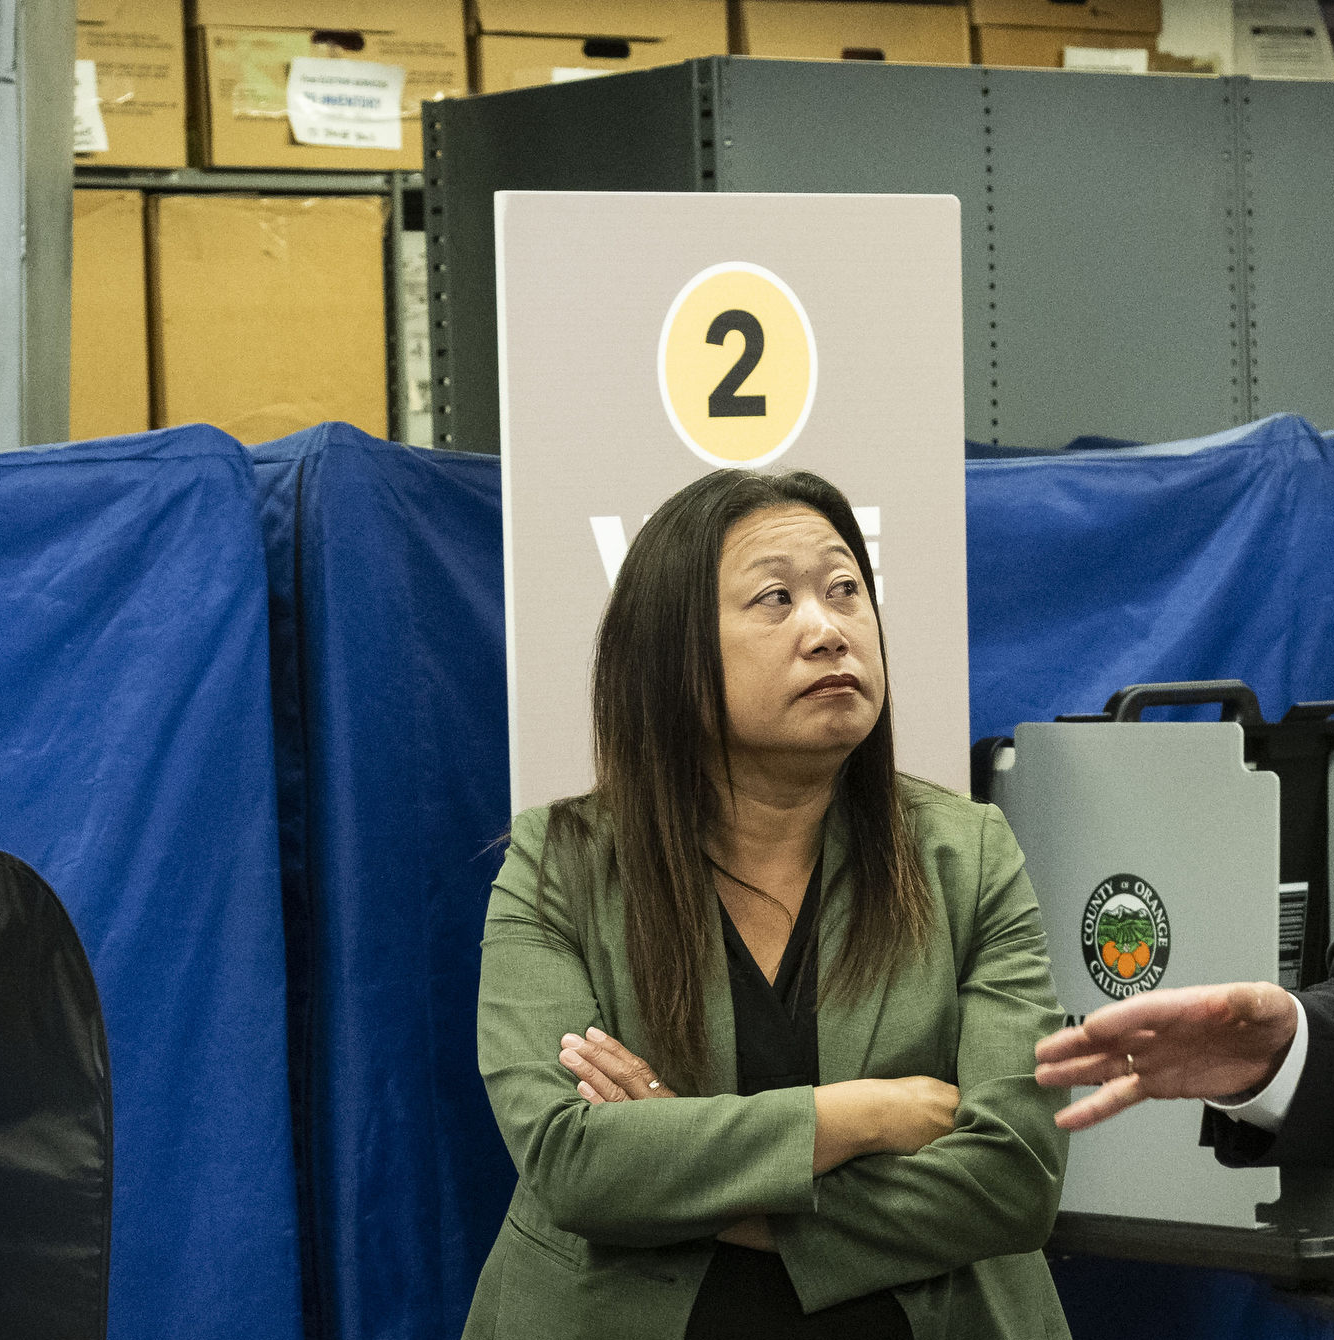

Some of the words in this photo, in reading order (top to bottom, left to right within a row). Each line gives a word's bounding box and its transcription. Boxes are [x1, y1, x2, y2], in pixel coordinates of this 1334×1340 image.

[705, 309, 766, 417] 2
[1083, 880, 1114, 946] COUNTY
[1134, 881, 1168, 947] ORANGE
[1089, 960, 1163, 998] CALIFORNIA
